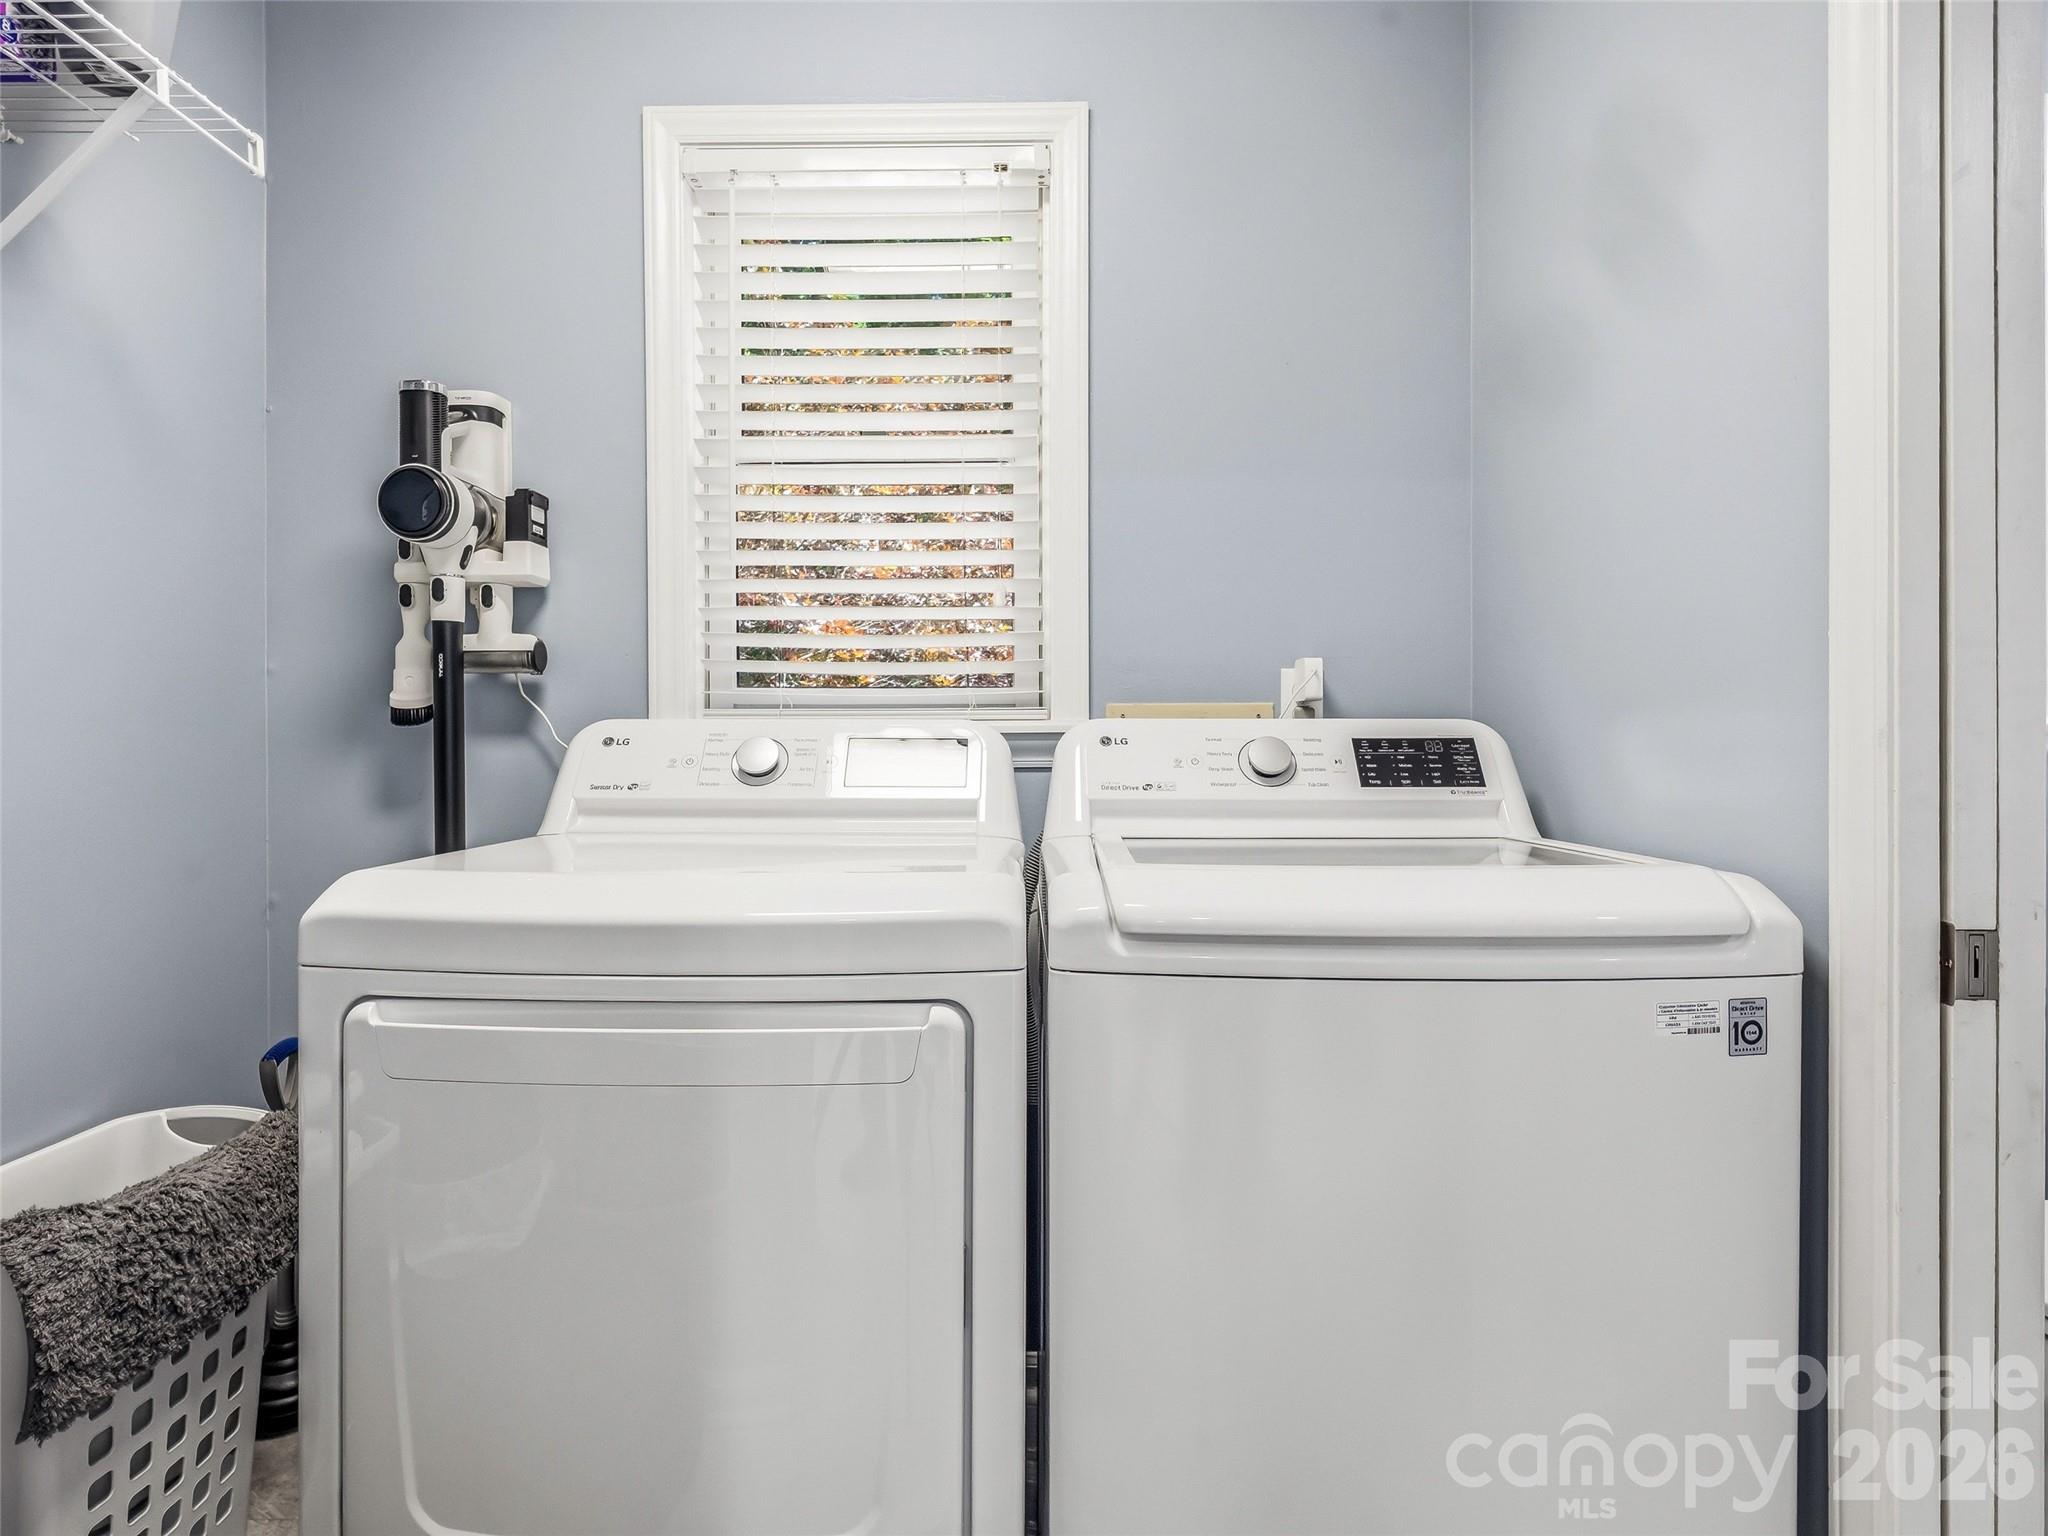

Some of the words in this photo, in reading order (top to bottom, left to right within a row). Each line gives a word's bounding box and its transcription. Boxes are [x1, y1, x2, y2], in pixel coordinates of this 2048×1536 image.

[615, 737, 631, 746] LG
[1114, 737, 1129, 746] LG
[589, 783, 612, 791] Sensor
[612, 783, 624, 791] Dry
[1732, 1020, 1763, 1045] 10
